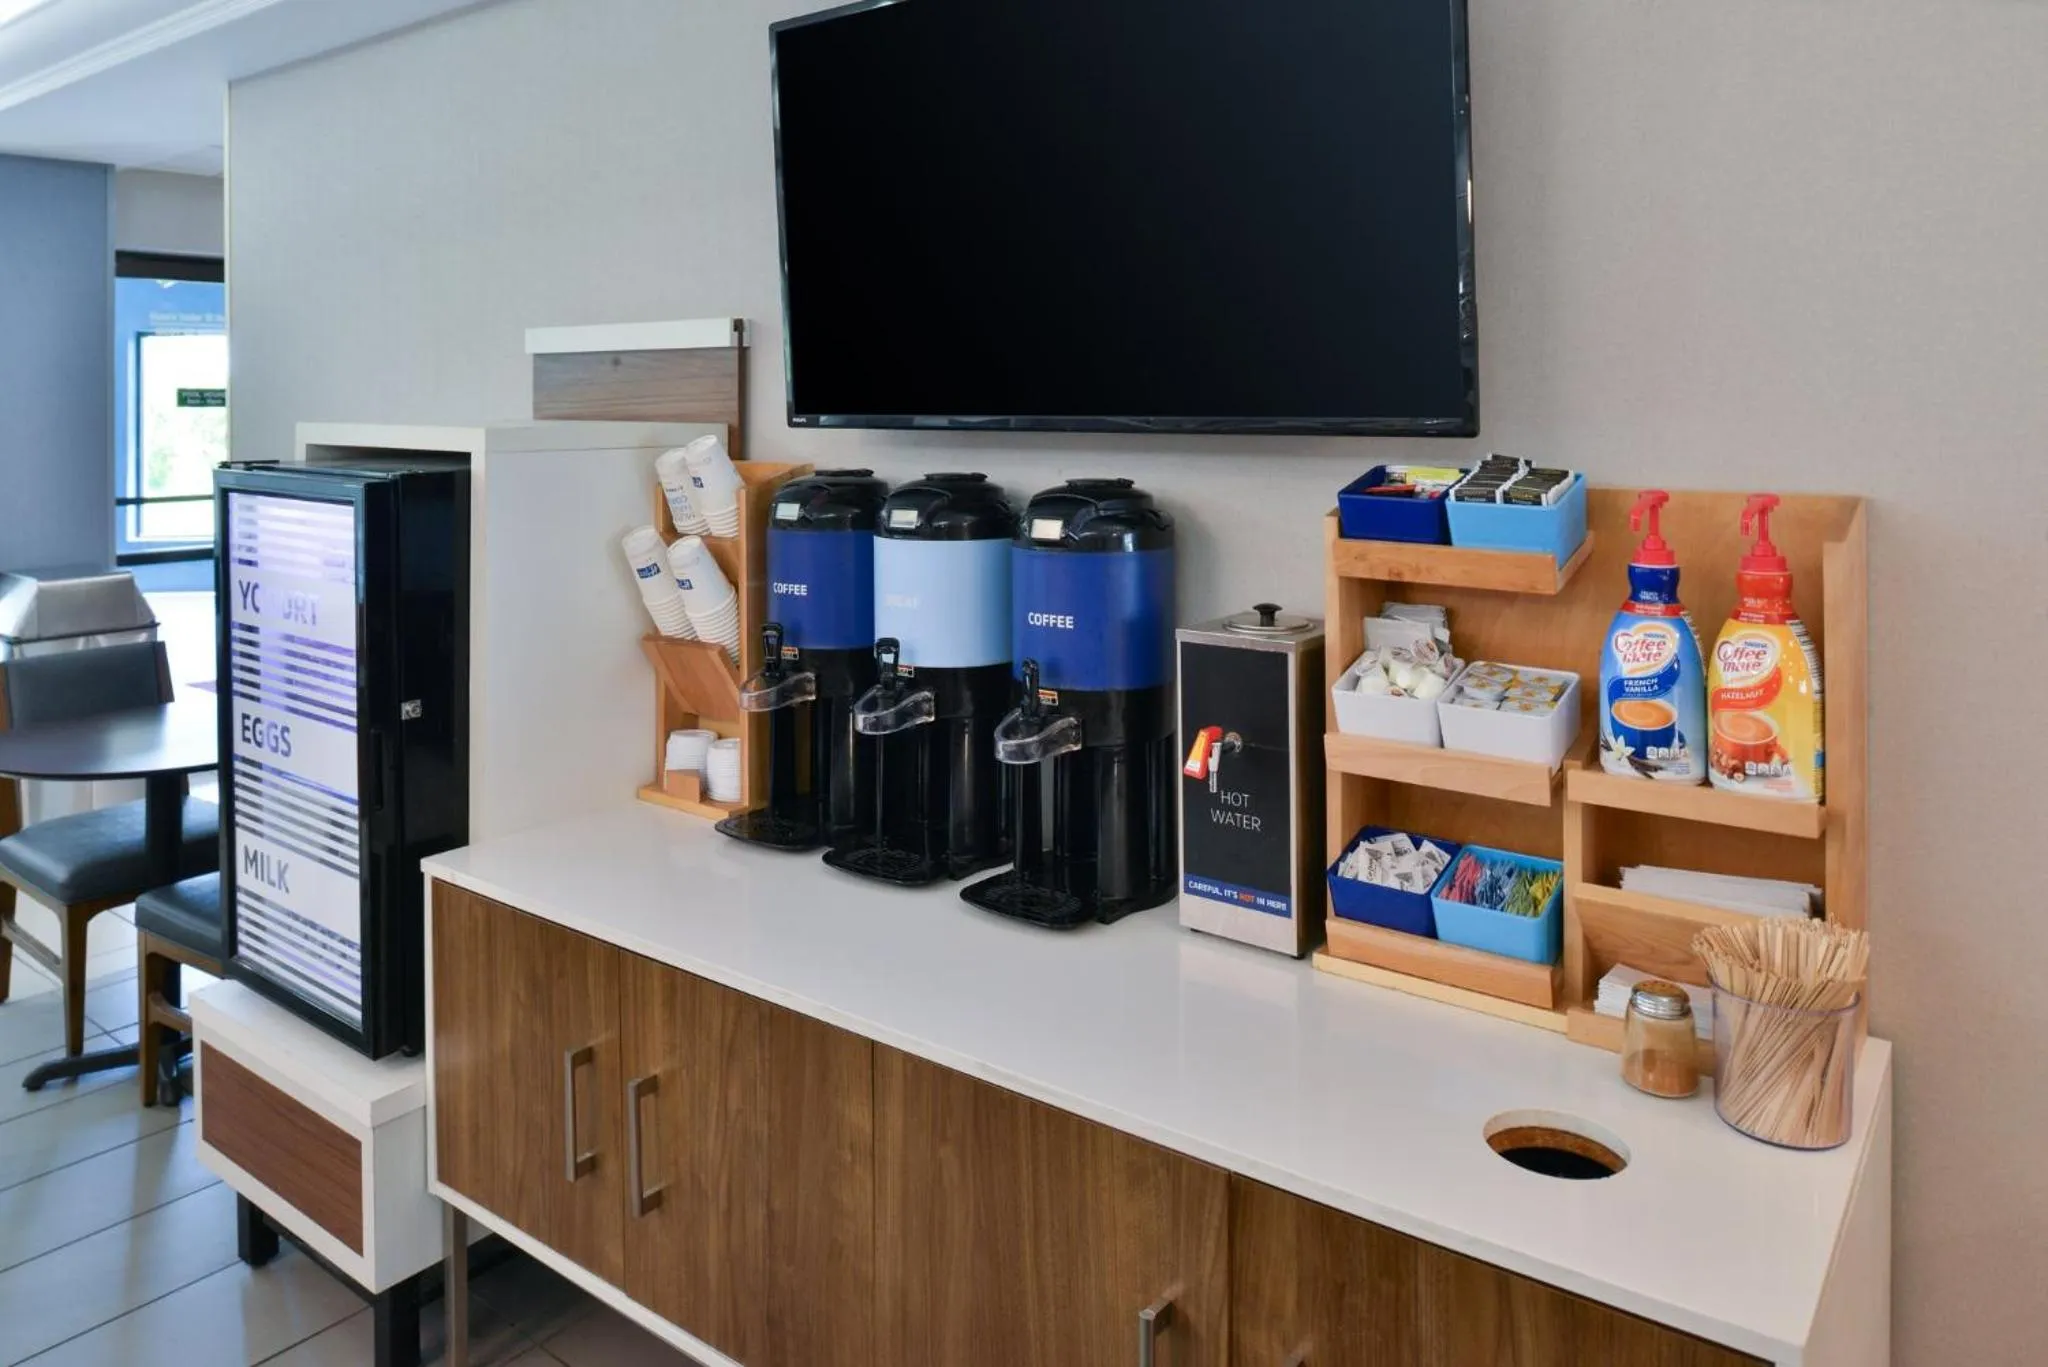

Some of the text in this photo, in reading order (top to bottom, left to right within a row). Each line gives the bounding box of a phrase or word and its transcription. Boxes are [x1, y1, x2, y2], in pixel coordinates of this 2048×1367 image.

[773, 582, 808, 596] COFFEE
[1028, 611, 1074, 629] COFFEE
[1624, 678, 1658, 686] FRENCH
[1624, 685, 1659, 693] VANILLA
[1720, 688, 1765, 700] HAZELNUT
[241, 713, 292, 758] EGGS
[1220, 790, 1251, 808] HOT
[1210, 807, 1262, 832] WATER
[243, 844, 290, 894] MILK
[1256, 896, 1265, 907] IN
